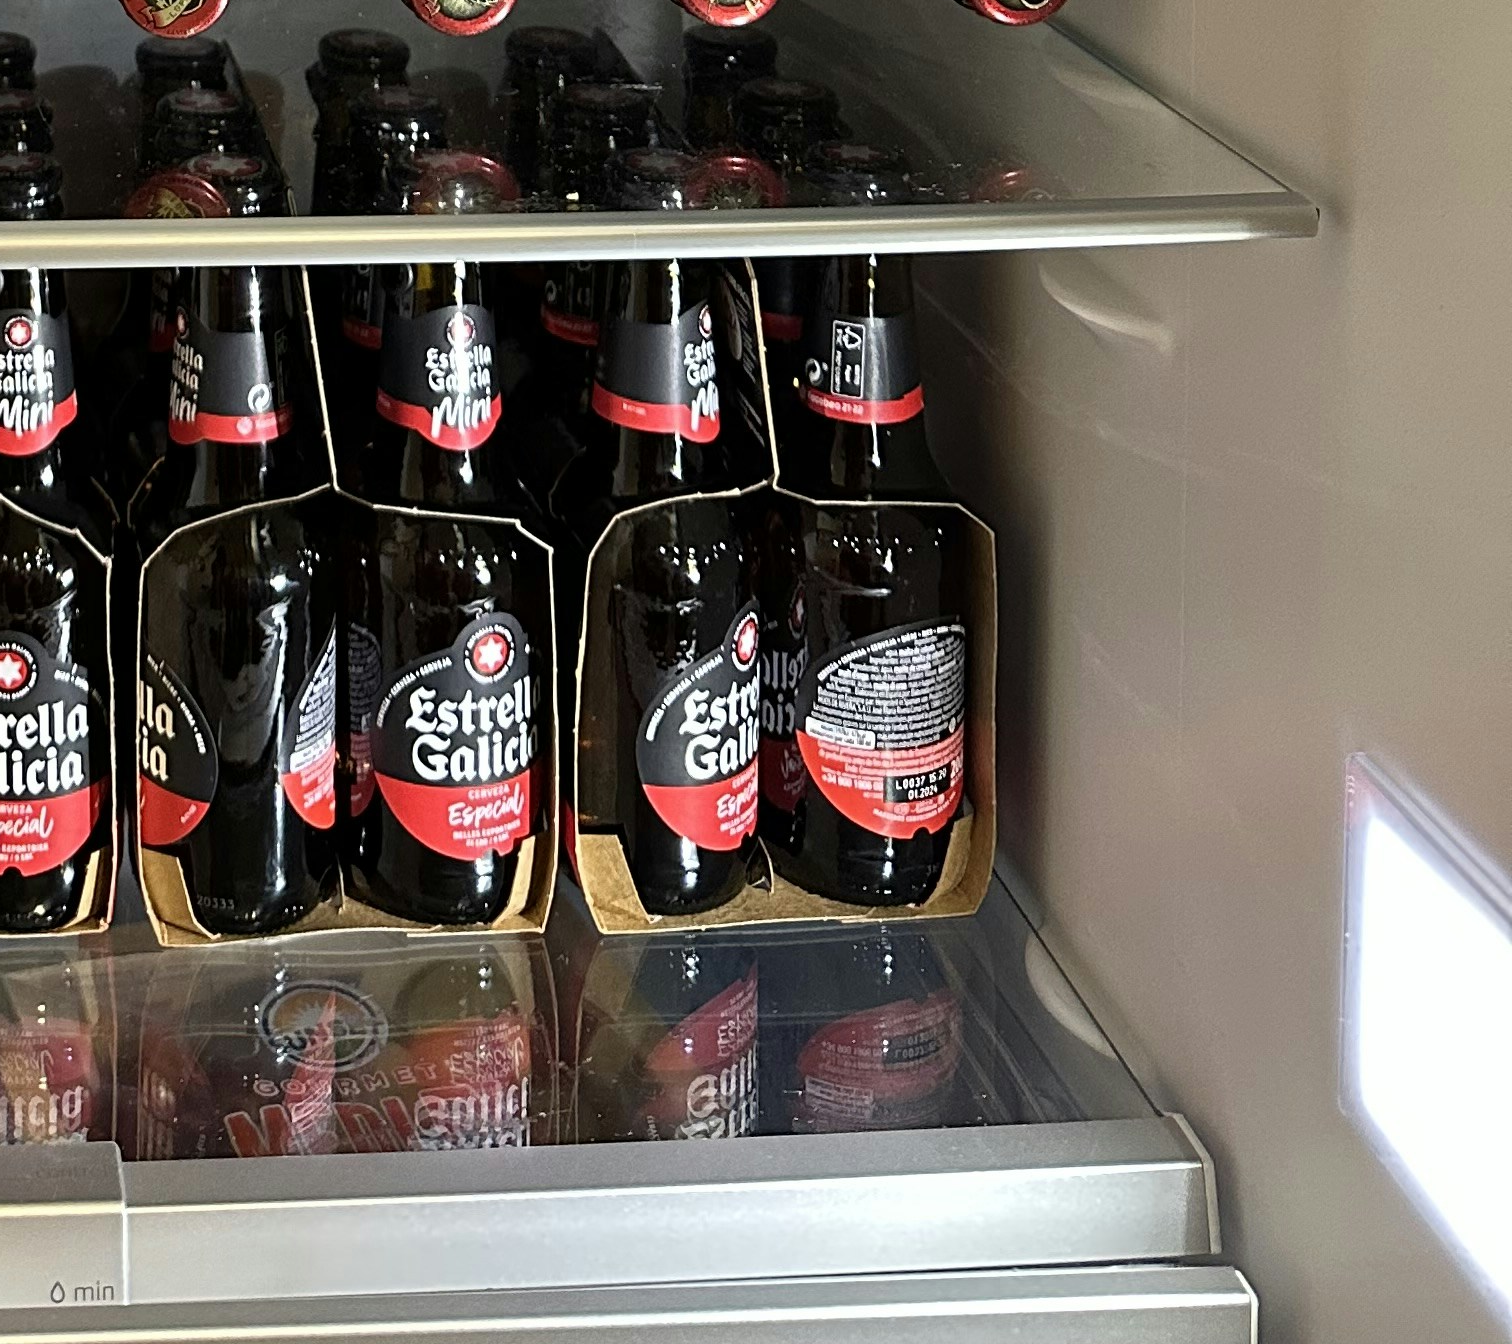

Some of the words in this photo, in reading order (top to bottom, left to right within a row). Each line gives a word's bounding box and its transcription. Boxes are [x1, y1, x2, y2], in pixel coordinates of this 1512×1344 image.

[424, 343, 493, 370] Estella
[428, 365, 491, 394] Gacia
[430, 386, 491, 439] Mini
[678, 664, 759, 735] Estre
[468, 784, 511, 800] CERVEZA
[895, 775, 926, 791] L0037
[447, 782, 525, 828] Especial
[73, 1281, 115, 1302] min
